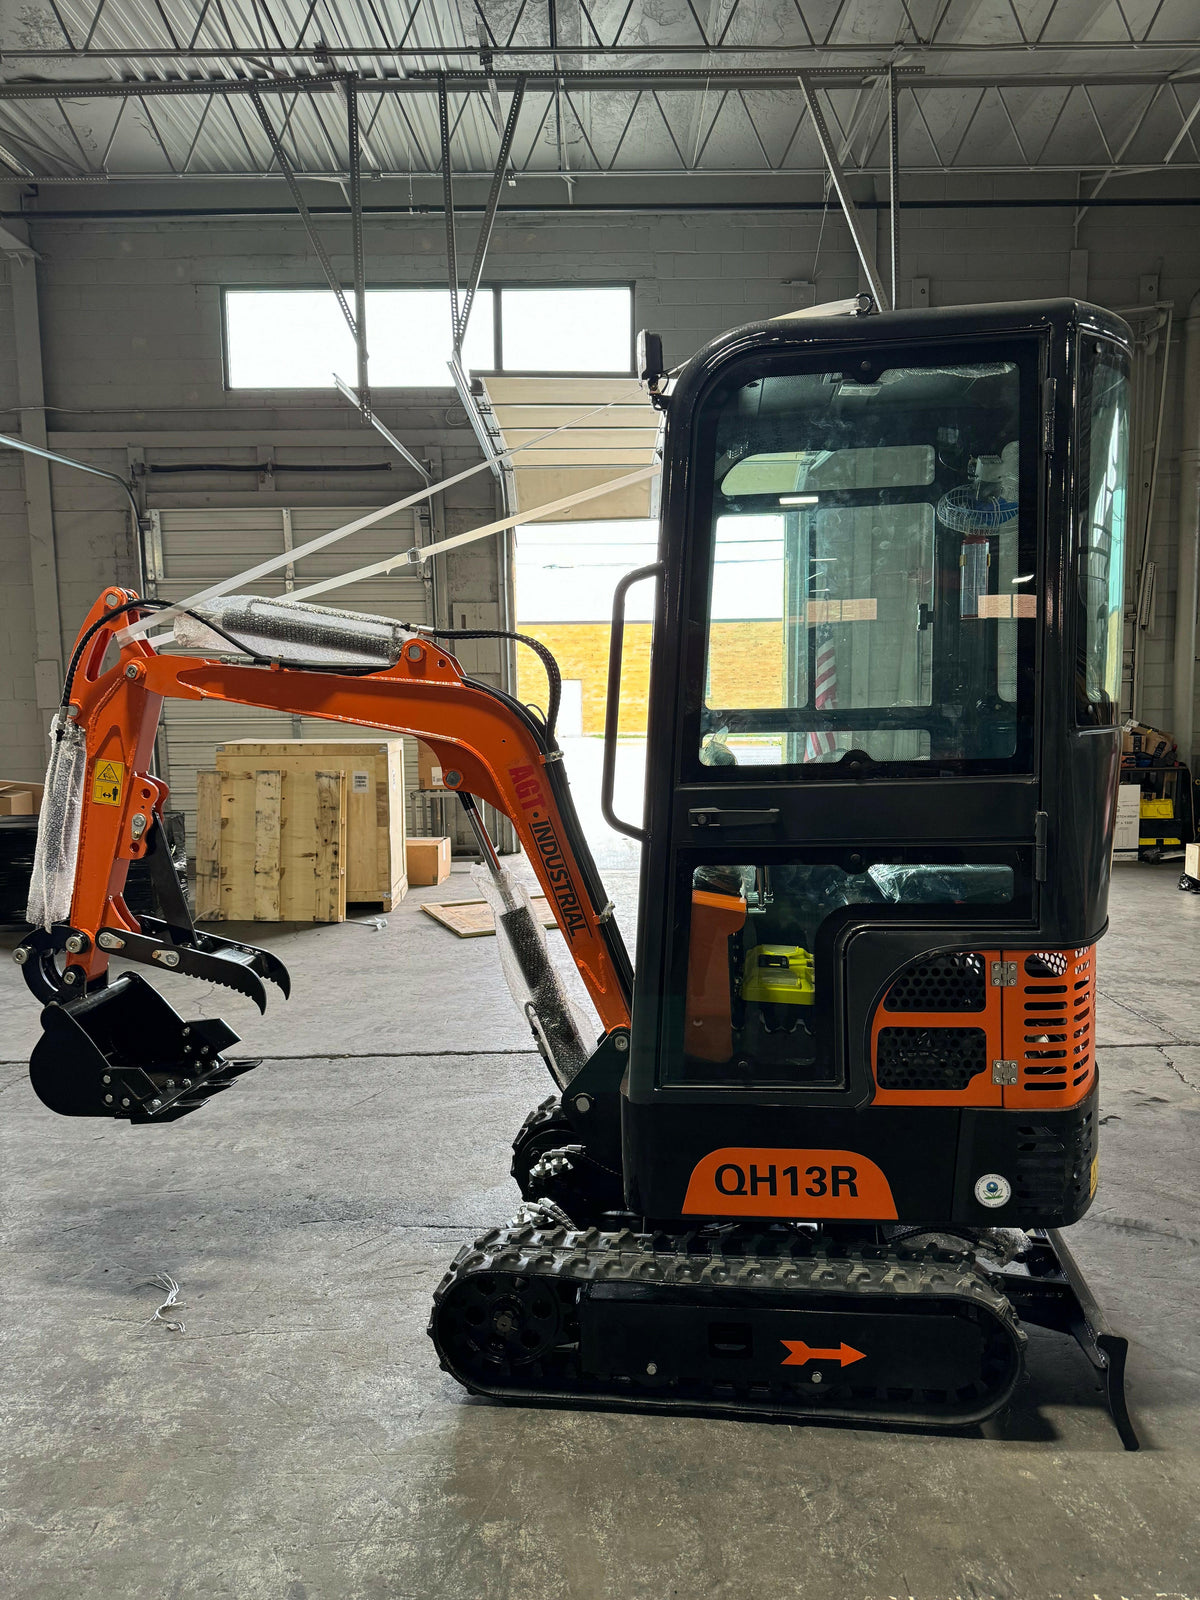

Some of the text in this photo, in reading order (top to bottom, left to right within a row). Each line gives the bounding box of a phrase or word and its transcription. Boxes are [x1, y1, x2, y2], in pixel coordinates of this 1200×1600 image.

[508, 765, 587, 938] AGT INDUSTRIAL
[714, 1163, 859, 1198] QH13R
